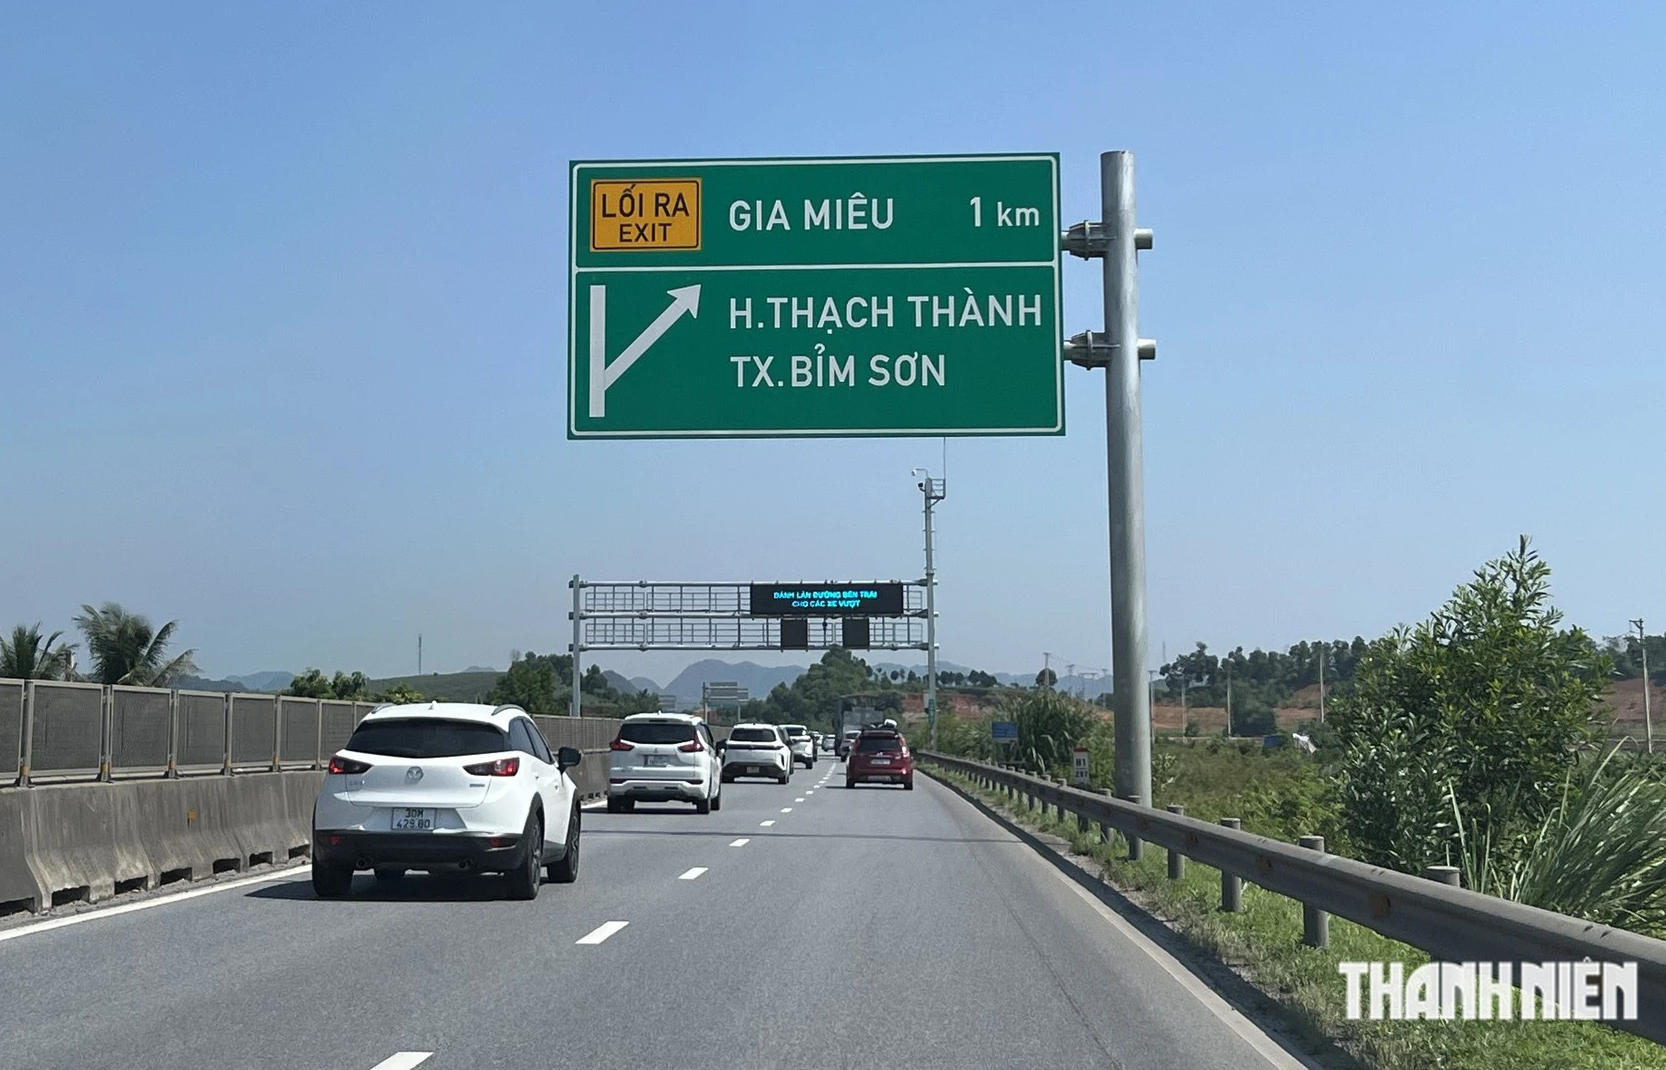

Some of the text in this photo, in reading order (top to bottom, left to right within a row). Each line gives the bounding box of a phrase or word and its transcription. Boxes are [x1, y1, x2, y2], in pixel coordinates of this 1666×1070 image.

[602, 184, 690, 218] LỐI RA
[729, 192, 1040, 231] GIA MIÊU 1 km
[619, 223, 672, 242] EXIT
[730, 288, 1042, 335] H.THẠCH THÀNH
[868, 351, 945, 387] SƠN
[810, 599, 826, 608] CÁC
